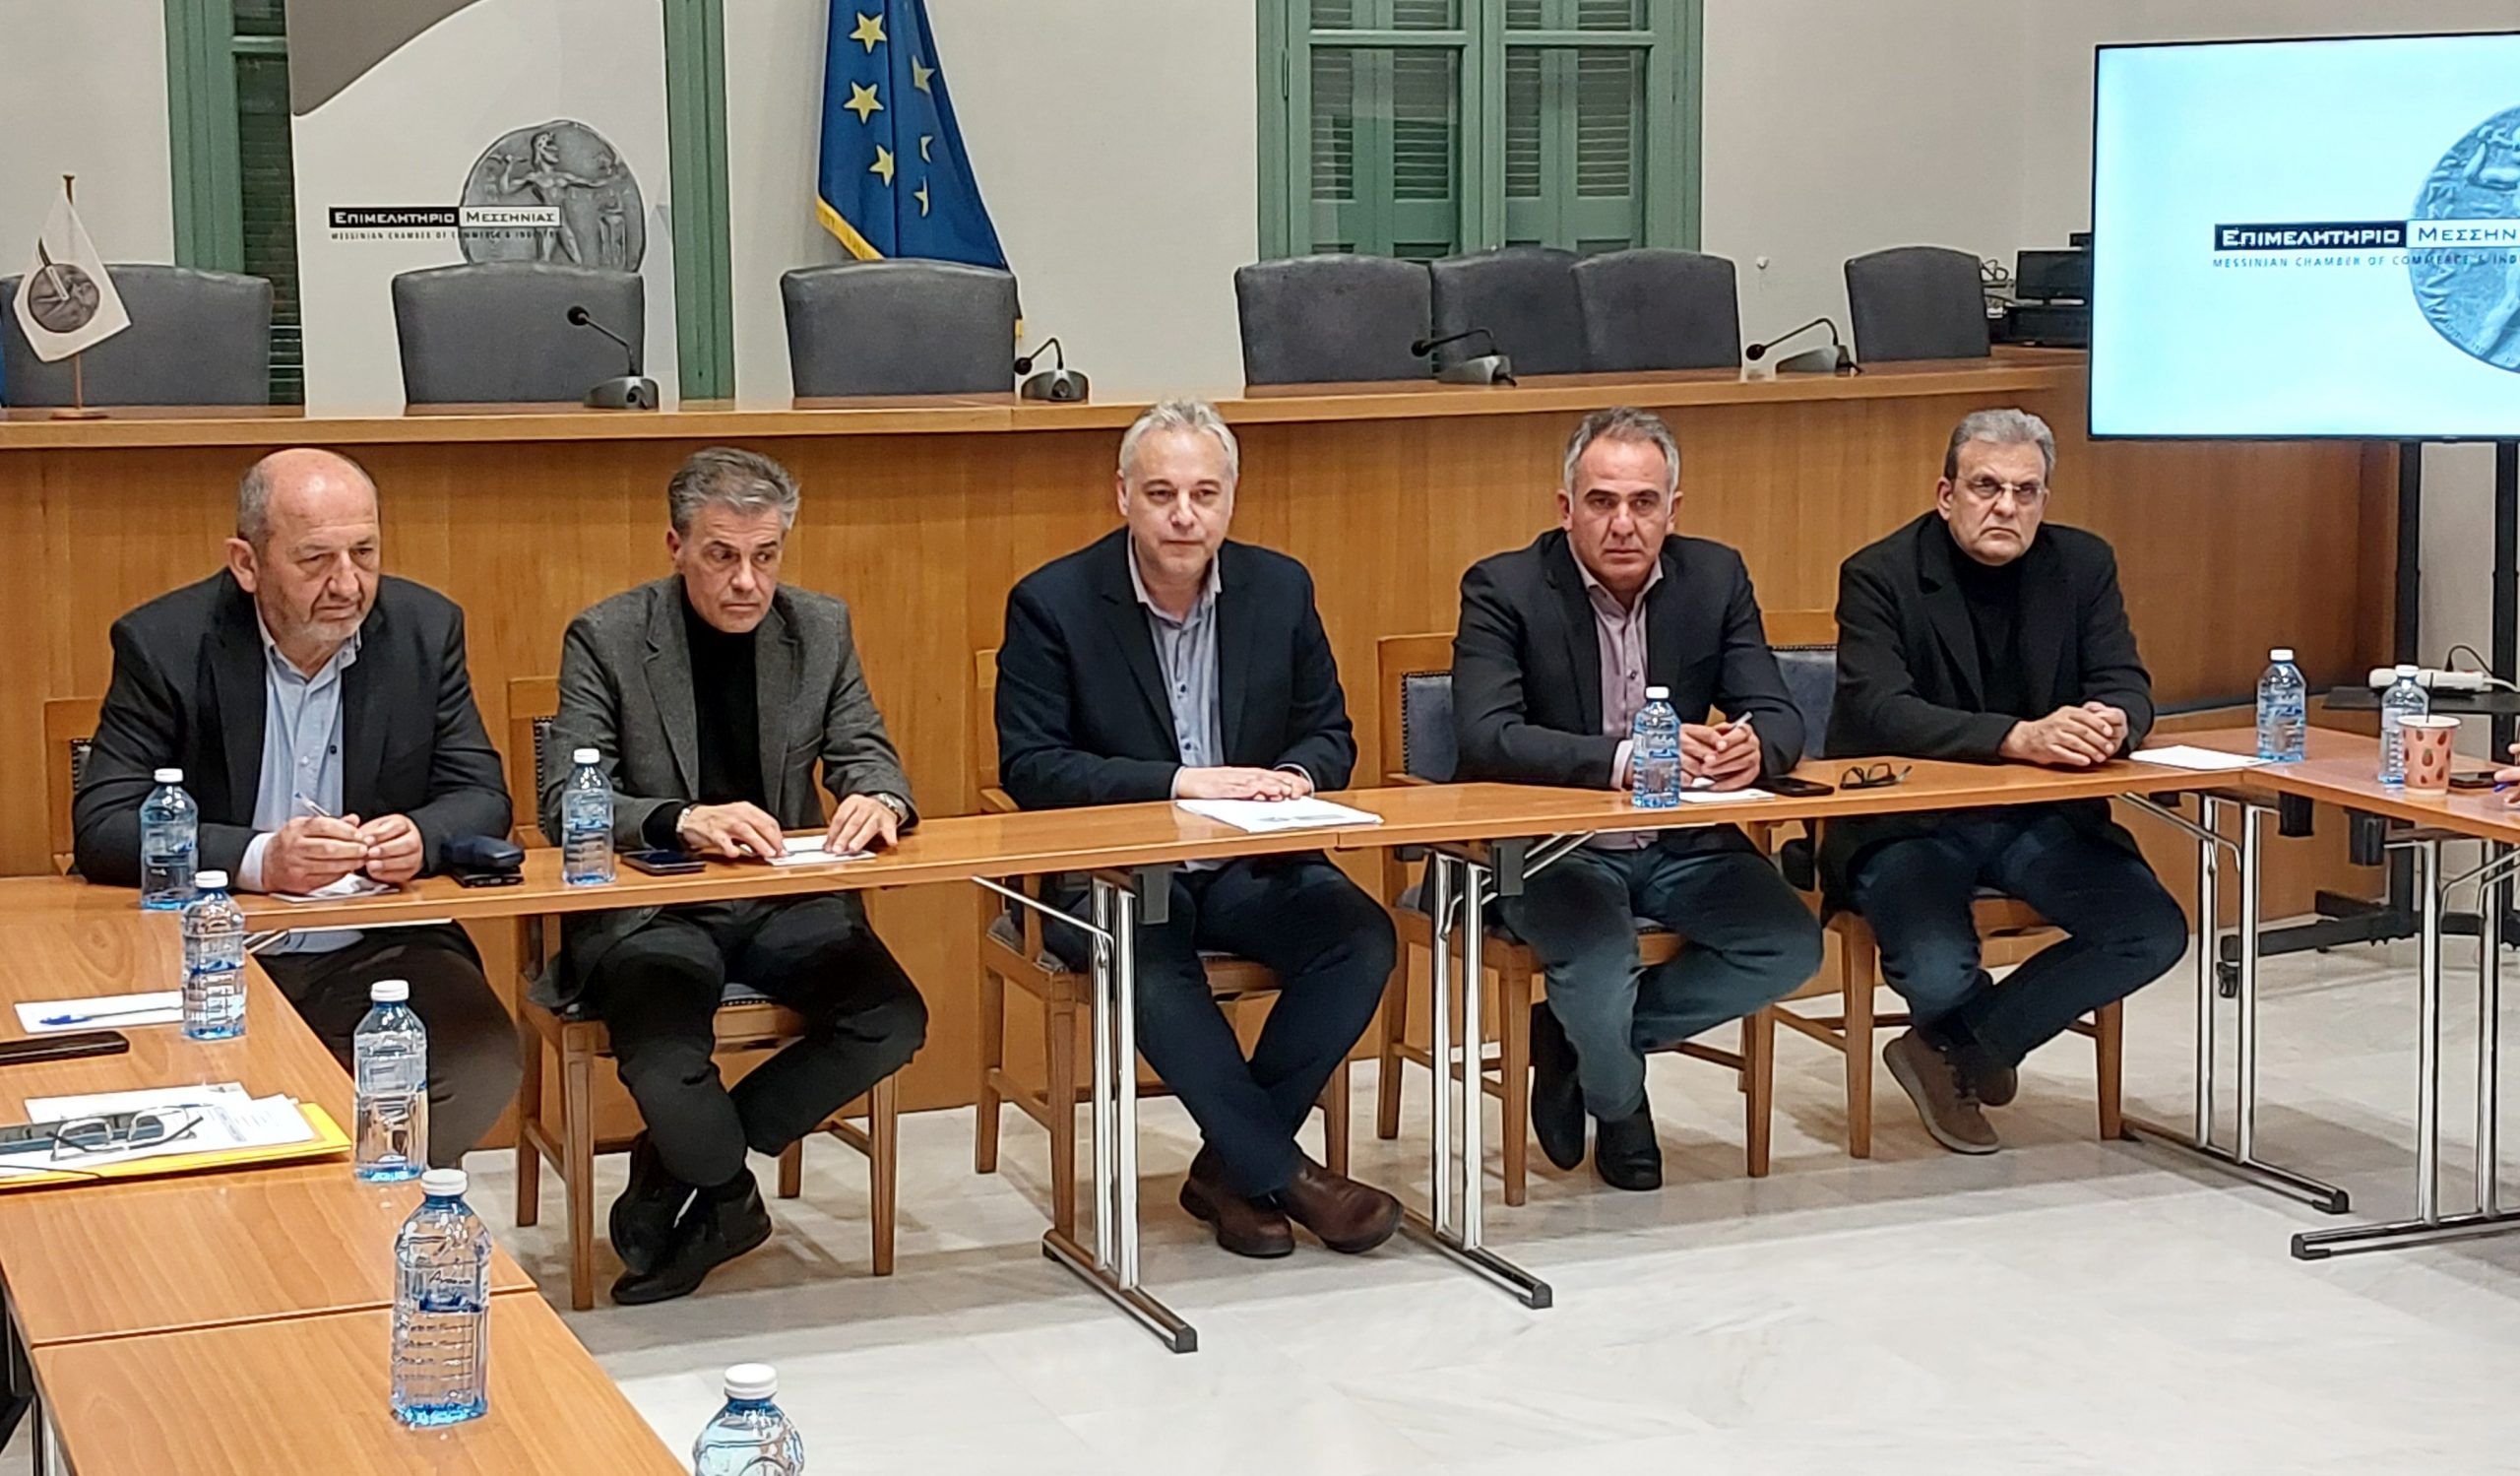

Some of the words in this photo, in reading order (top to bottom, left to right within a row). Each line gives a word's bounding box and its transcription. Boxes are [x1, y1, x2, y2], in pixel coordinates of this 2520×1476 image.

[388, 230, 431, 239] CHAMBER
[2222, 227, 2400, 247] ΕΠΙΜΕΛΗΤΗΡΙΟ
[2212, 257, 2289, 268] MESSINIAN
[2296, 256, 2361, 267] CHAMBER
[2367, 255, 2386, 266] OF
